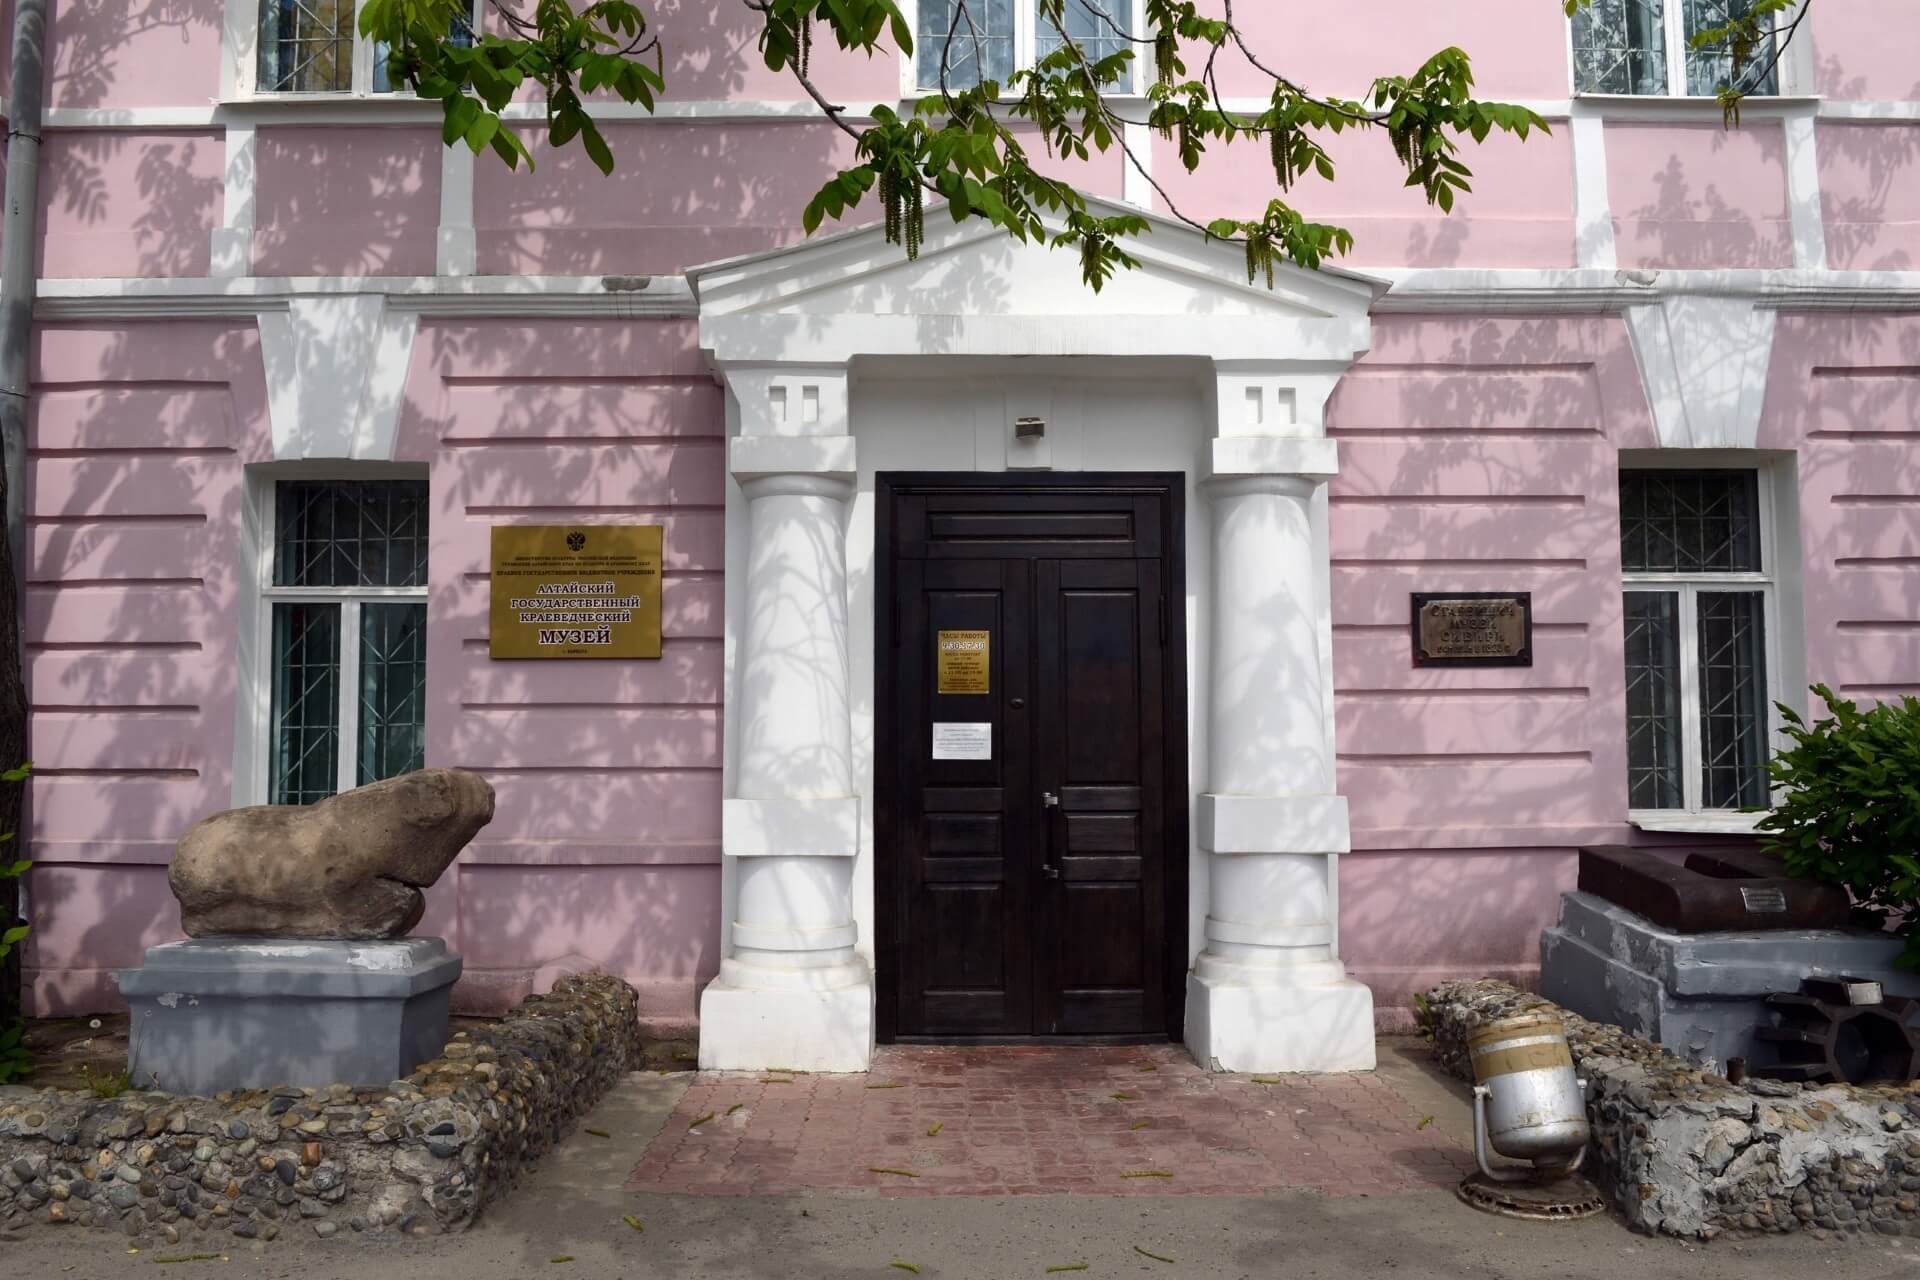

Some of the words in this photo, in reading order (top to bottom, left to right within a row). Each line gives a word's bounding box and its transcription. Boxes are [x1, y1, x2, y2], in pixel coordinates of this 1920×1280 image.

[537, 581, 615, 594] АЛТАЙСКИЙ
[511, 596, 640, 609] ГОСУДАРСТВЕННЫЙ
[520, 610, 631, 623] КРАЕВЕДЧЕСКИЙ
[539, 625, 612, 644] МУЗЕЙ
